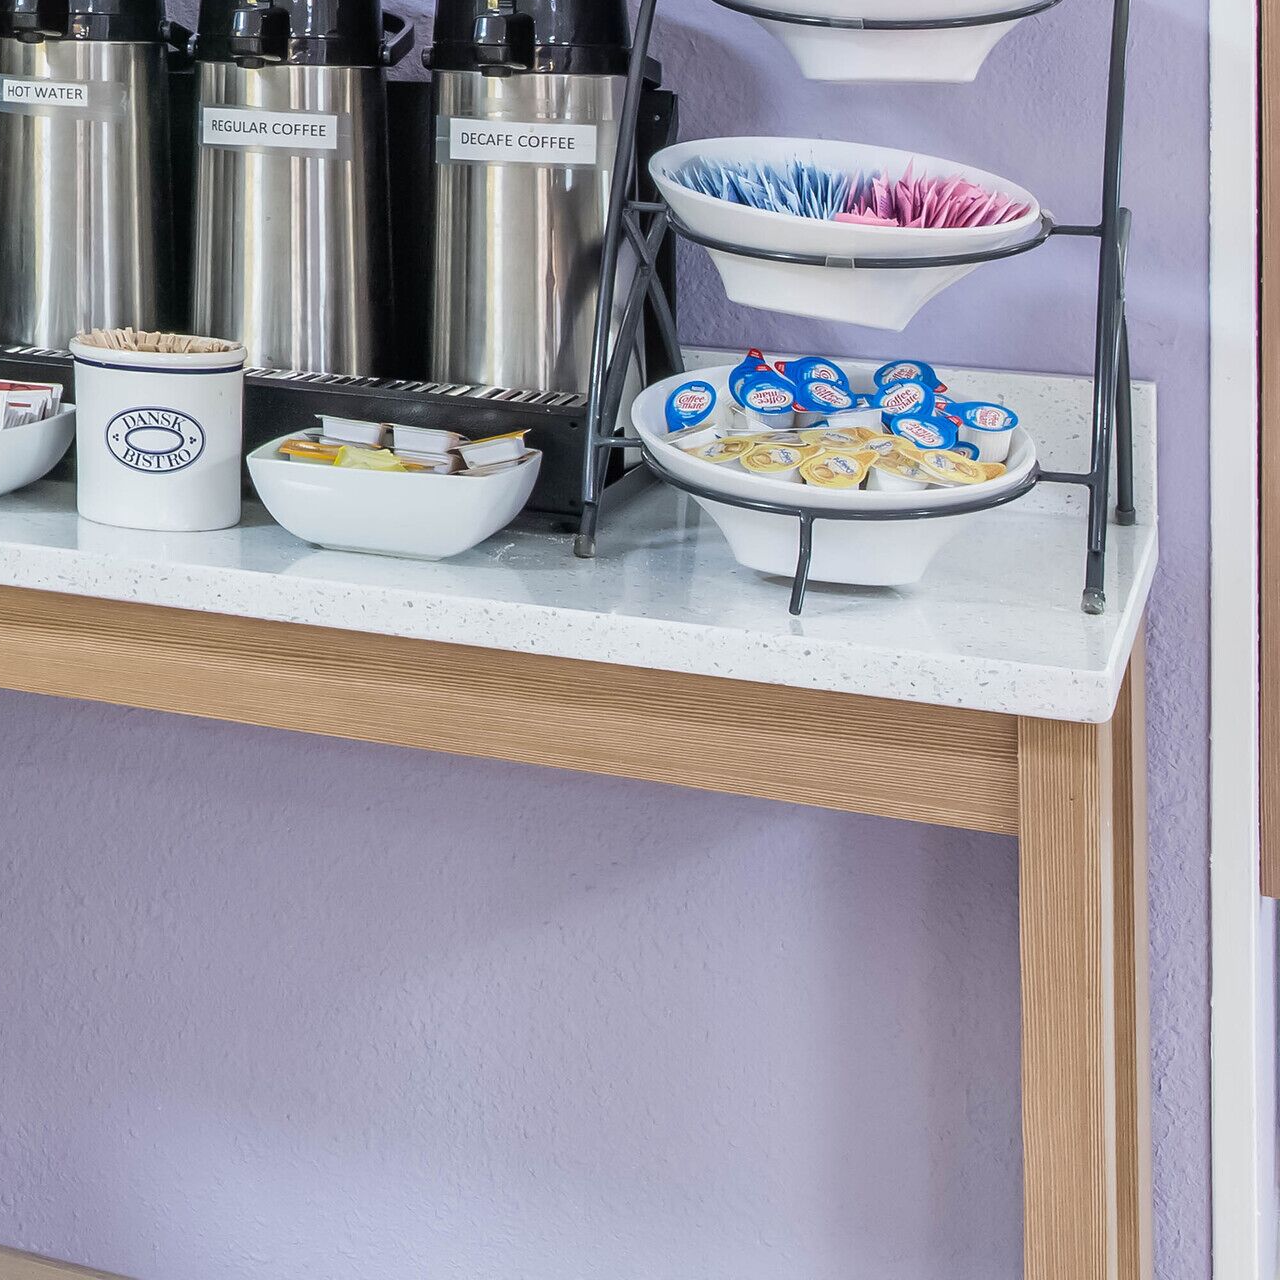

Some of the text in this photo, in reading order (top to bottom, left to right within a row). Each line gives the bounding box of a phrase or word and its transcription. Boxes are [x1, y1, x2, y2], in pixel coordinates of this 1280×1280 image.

[7, 85, 83, 100] HOT WATER
[211, 119, 327, 137] REGULAR COFFEE
[460, 131, 576, 150] DECAFE COFFEE
[678, 394, 705, 404] Coffee
[122, 411, 187, 433] DANSK
[122, 447, 191, 469] BISTRO
